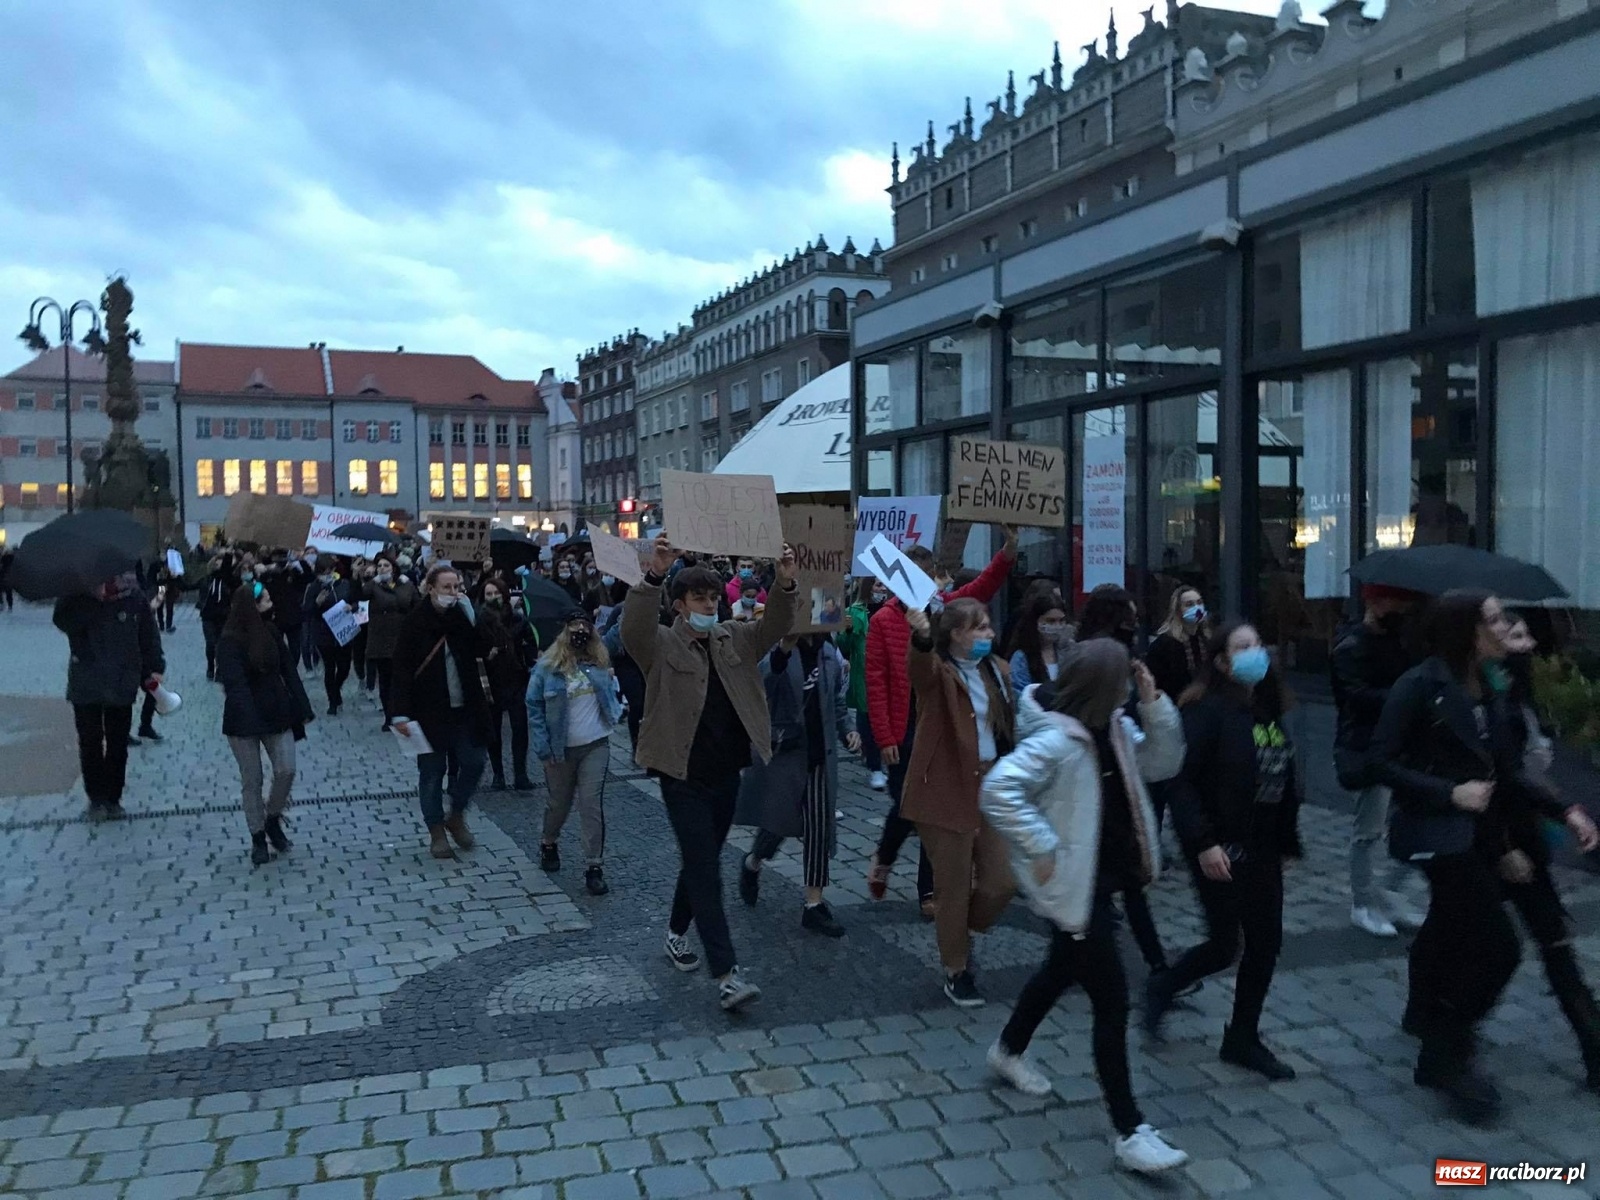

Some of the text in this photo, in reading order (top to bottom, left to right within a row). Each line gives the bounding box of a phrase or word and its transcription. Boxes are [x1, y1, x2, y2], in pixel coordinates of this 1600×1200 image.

[960, 441, 1055, 473] REAL MEN
[981, 467, 1031, 490] ARE
[958, 484, 1062, 515] FEMINISTS
[857, 506, 906, 531] WYBÓR
